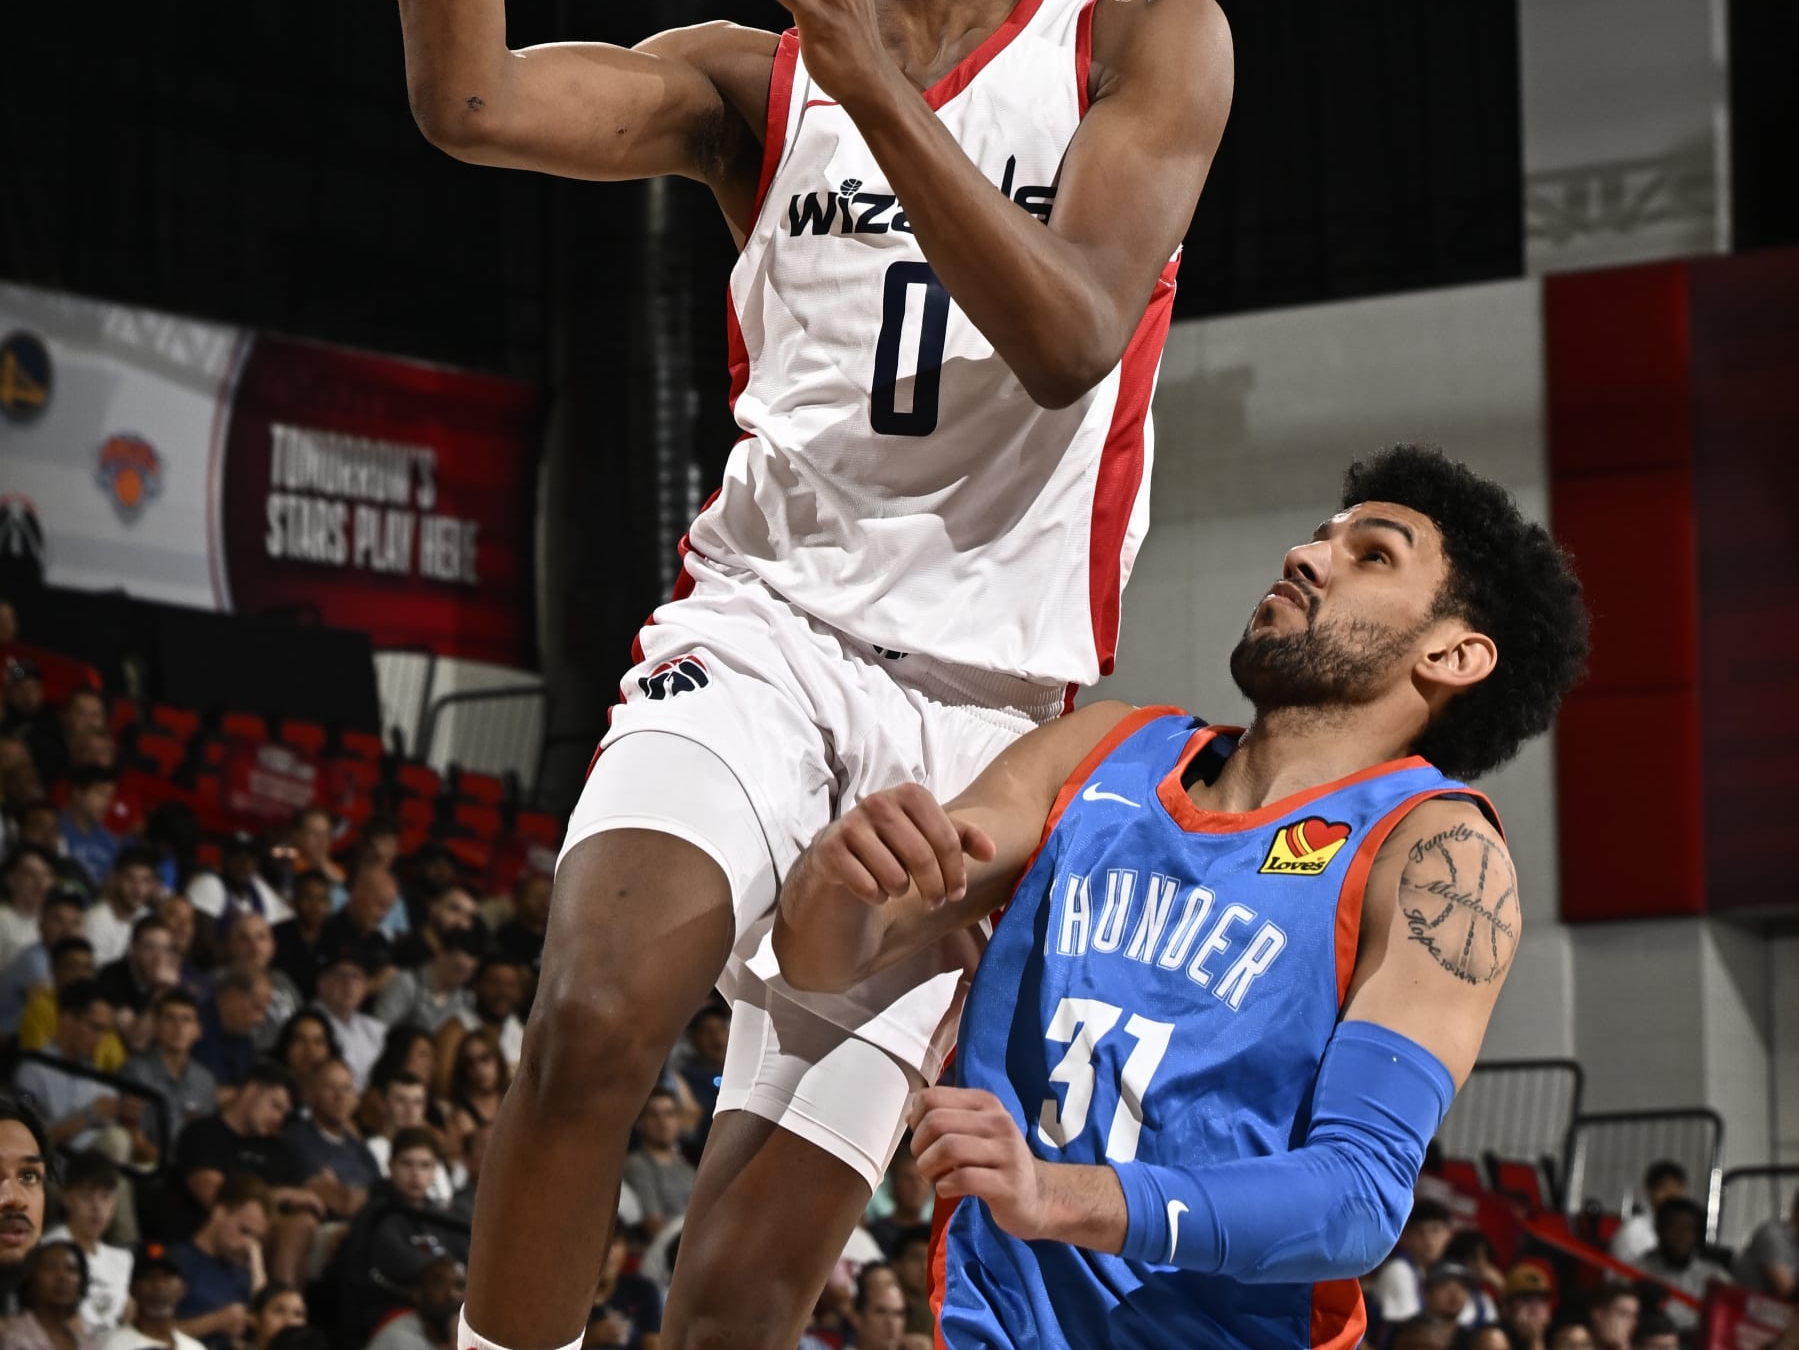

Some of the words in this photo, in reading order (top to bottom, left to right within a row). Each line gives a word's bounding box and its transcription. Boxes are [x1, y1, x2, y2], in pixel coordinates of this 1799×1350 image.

[870, 261, 951, 437] 0
[266, 492, 349, 566] STARS
[353, 503, 415, 575] PLAY
[419, 514, 480, 586] HERE
[1408, 823, 1474, 863] Family
[1044, 868, 1287, 1012] HUNDER
[1403, 908, 1441, 961] Hope
[1414, 880, 1513, 939] Maldonado
[1037, 997, 1175, 1164] 31
